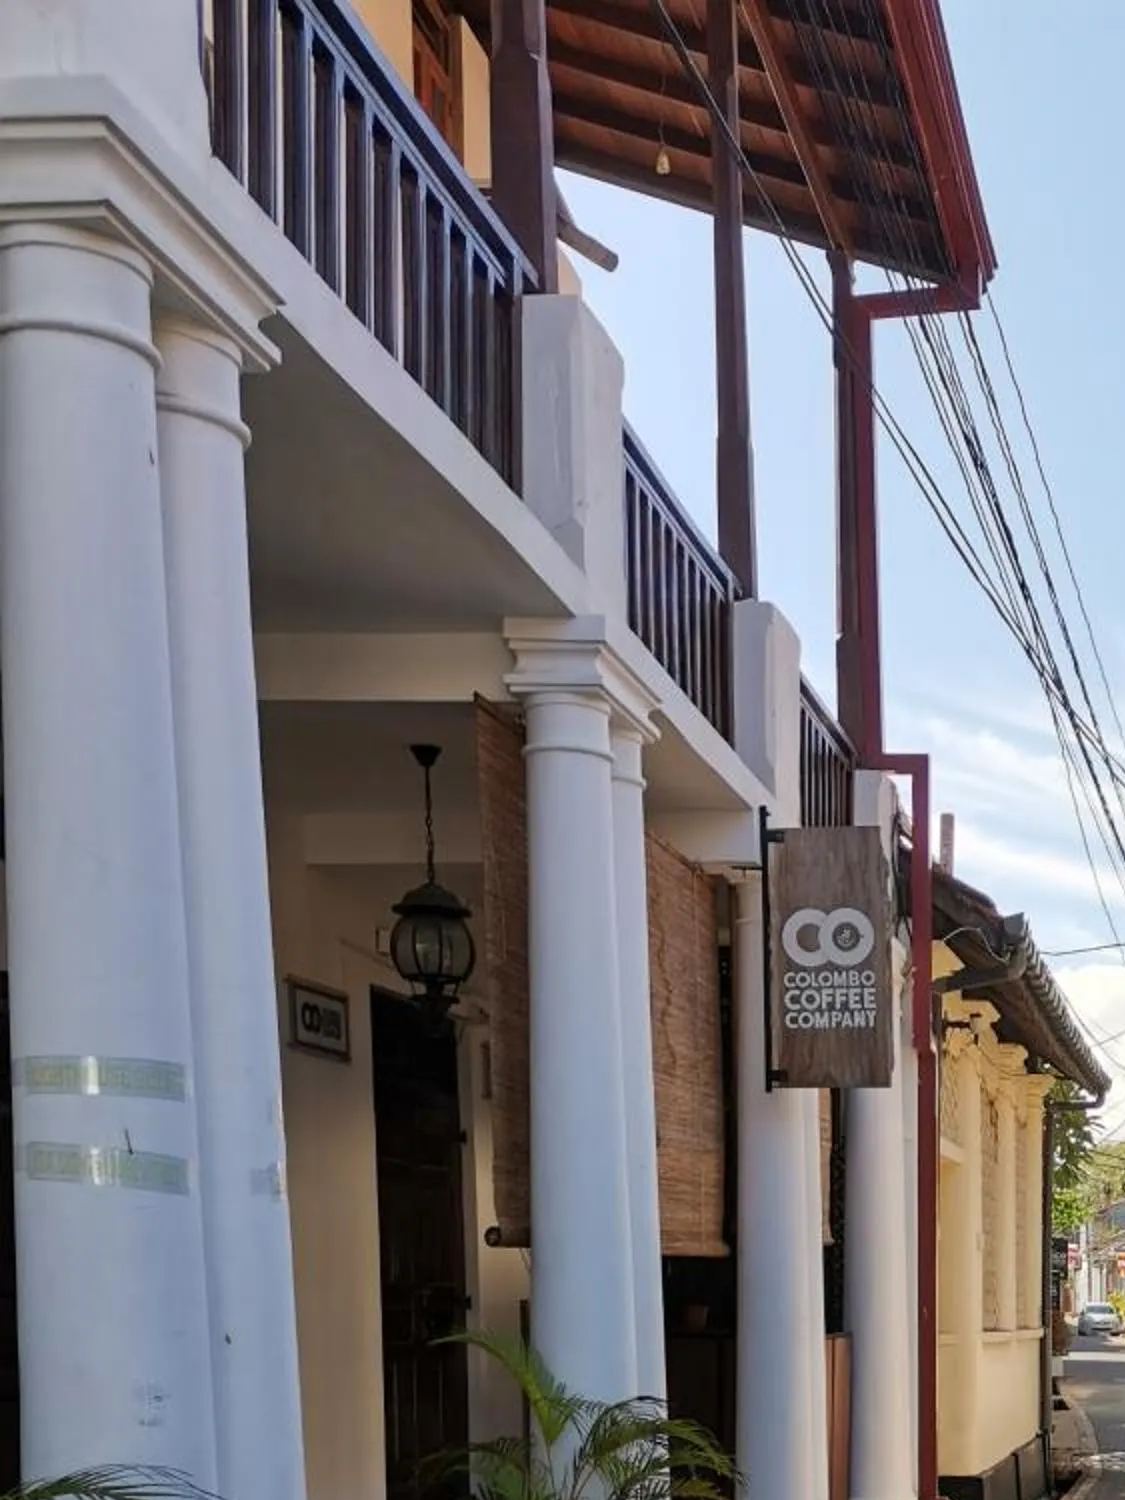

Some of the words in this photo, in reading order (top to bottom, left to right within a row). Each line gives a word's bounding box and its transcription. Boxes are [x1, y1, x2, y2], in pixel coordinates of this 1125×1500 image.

[784, 971, 875, 988] COLOMBO
[785, 988, 876, 1010] COFFEE
[785, 1011, 876, 1029] COMPANY
